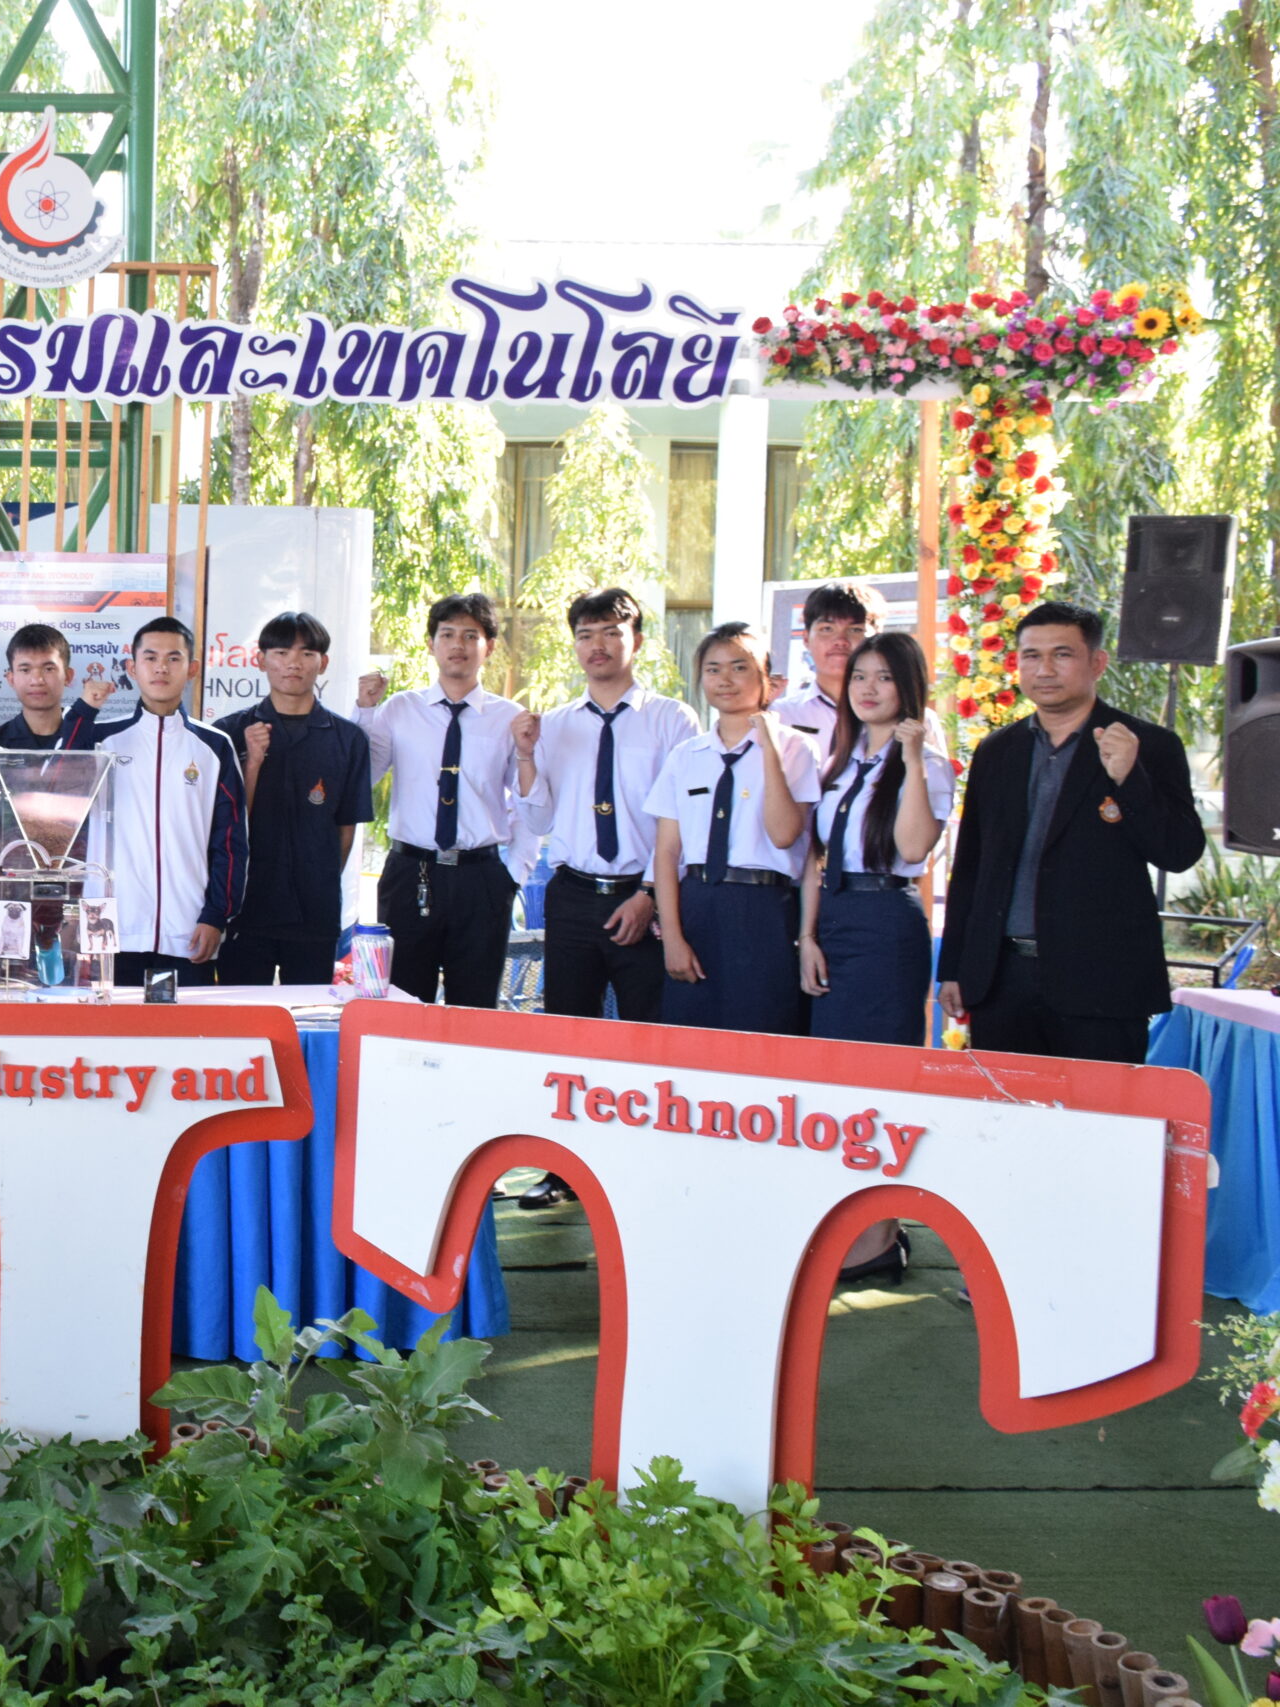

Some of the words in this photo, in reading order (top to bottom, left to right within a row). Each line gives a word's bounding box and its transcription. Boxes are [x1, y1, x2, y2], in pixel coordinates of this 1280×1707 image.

[59, 620, 81, 632] dog
[85, 620, 120, 630] slaves
[171, 1055, 269, 1102] and
[543, 1070, 927, 1178] Technology
